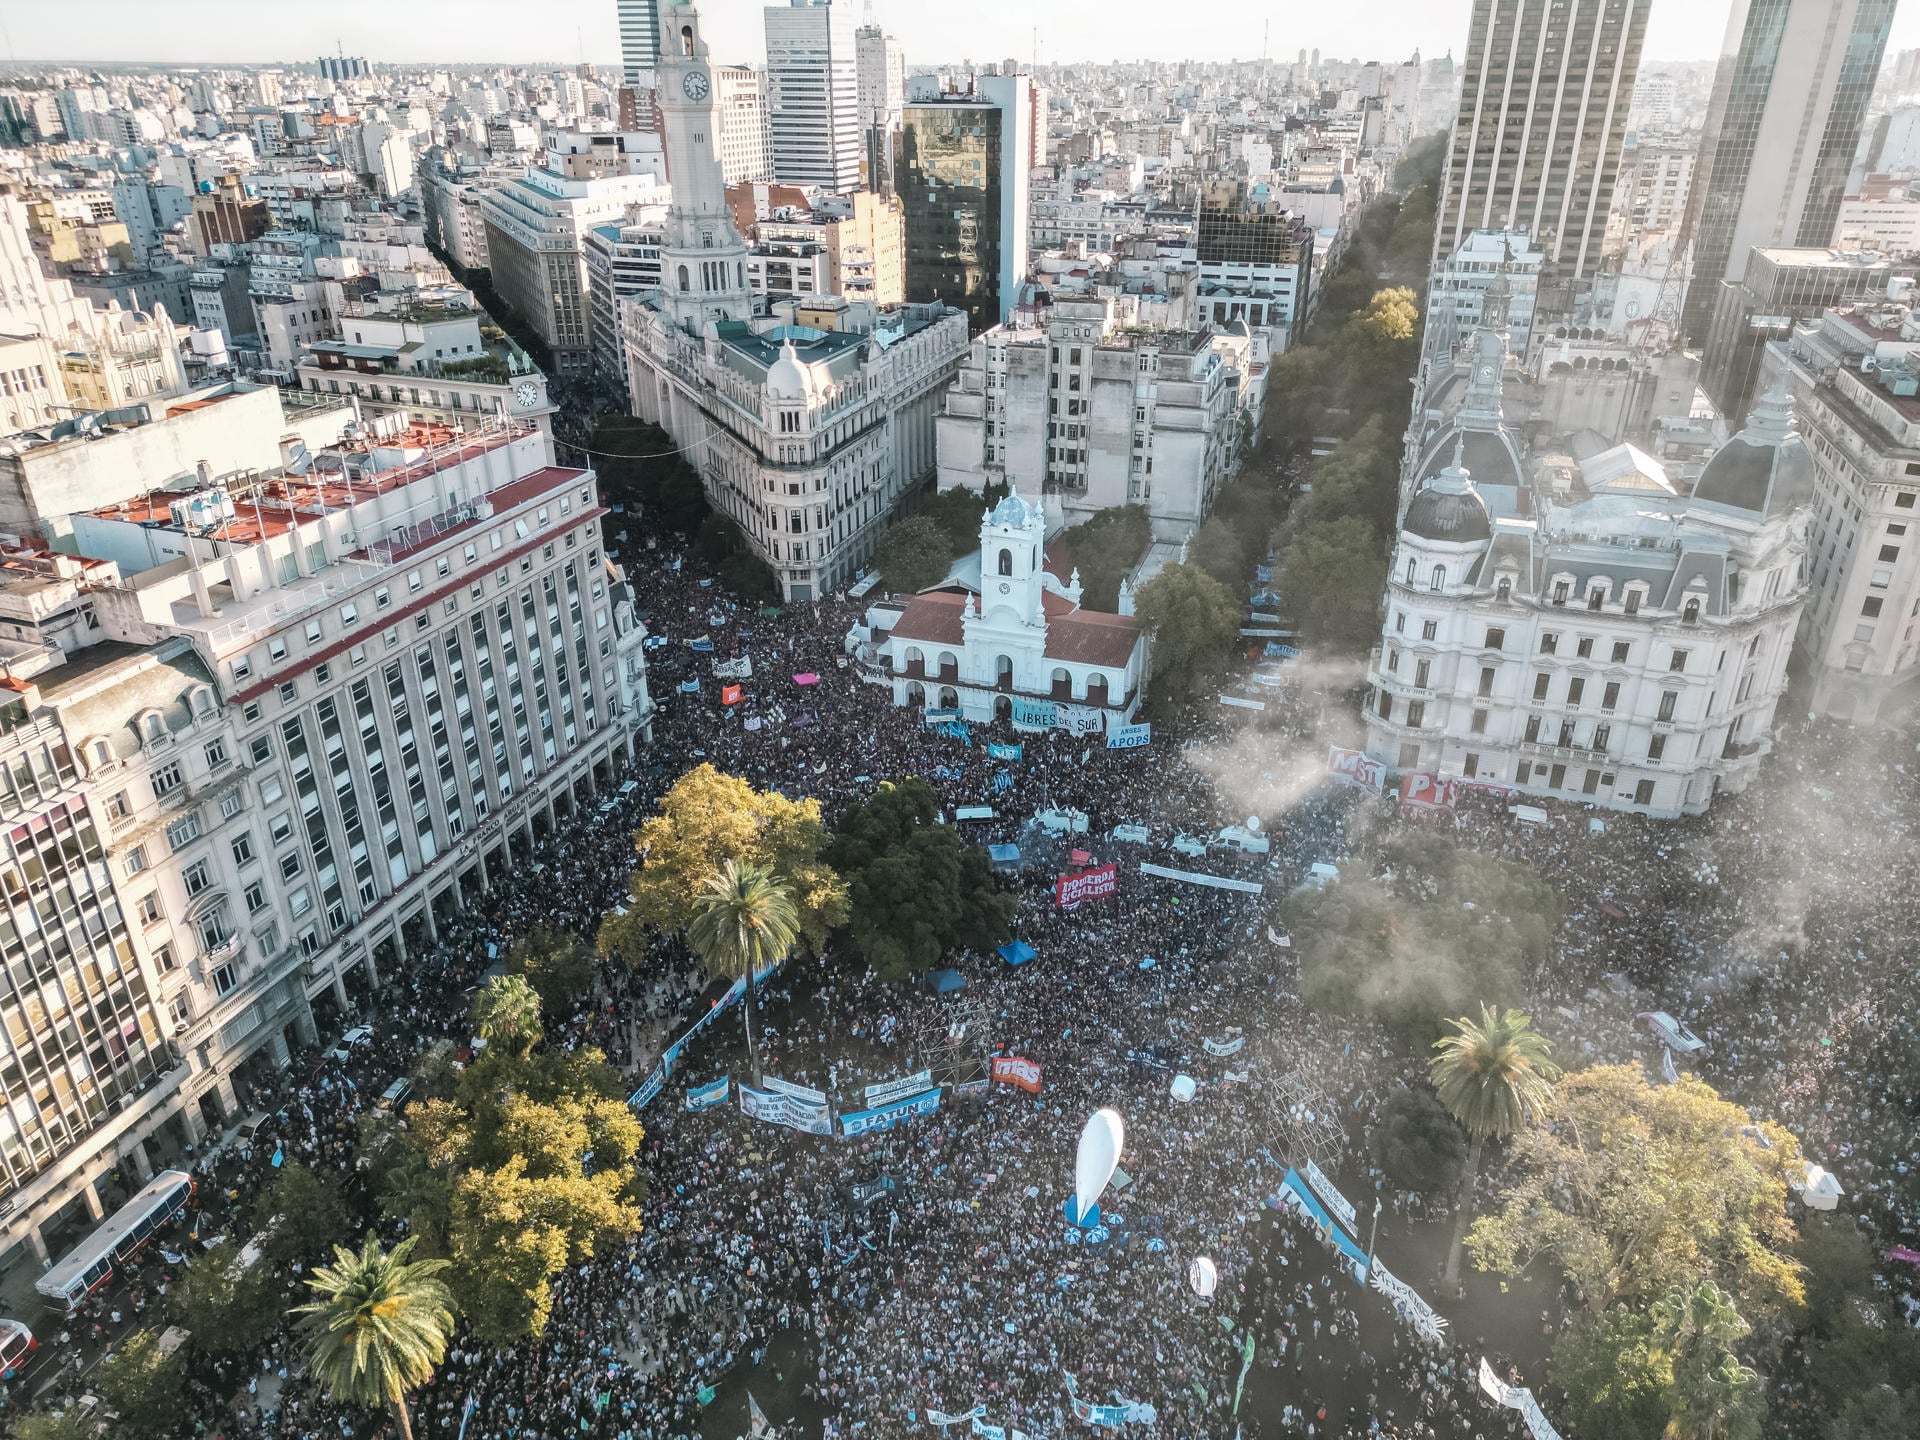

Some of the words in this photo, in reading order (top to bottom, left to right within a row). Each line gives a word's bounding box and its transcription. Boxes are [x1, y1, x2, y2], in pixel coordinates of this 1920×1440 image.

[1015, 707, 1056, 726] LIBRES
[1058, 717, 1073, 728] DEL
[1077, 718, 1098, 731] SUR
[1120, 726, 1142, 736] ANSES
[1109, 734, 1149, 747] APOPS
[460, 844, 469, 855] LA
[473, 819, 500, 845] FRANCO
[503, 787, 540, 818] ARGENTINA
[757, 1103, 779, 1111] NUEVA
[865, 1103, 919, 1127] FATUN
